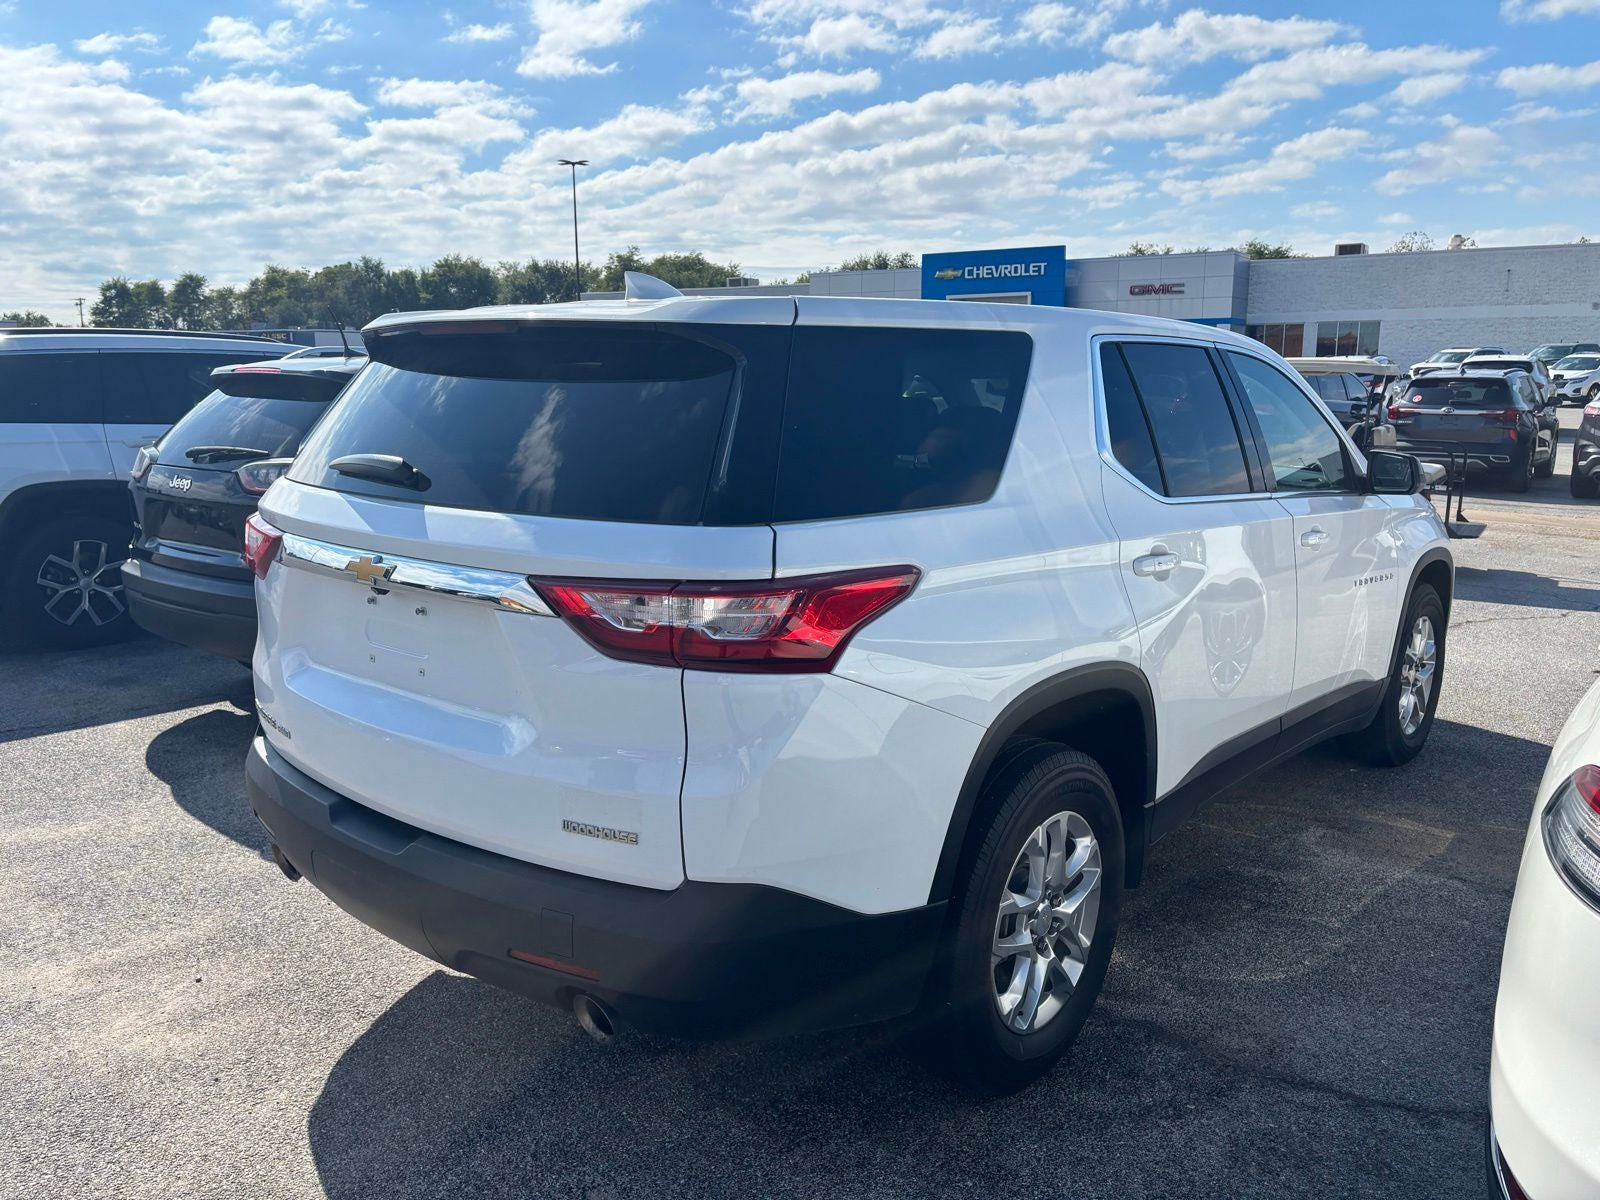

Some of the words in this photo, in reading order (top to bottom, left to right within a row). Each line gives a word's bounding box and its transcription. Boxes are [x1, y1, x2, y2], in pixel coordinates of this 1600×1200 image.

[964, 262, 1048, 280] CHEVROLET
[1129, 283, 1185, 296] GMC
[169, 474, 192, 492] Jeep
[562, 819, 639, 846] WOODHOUSE
